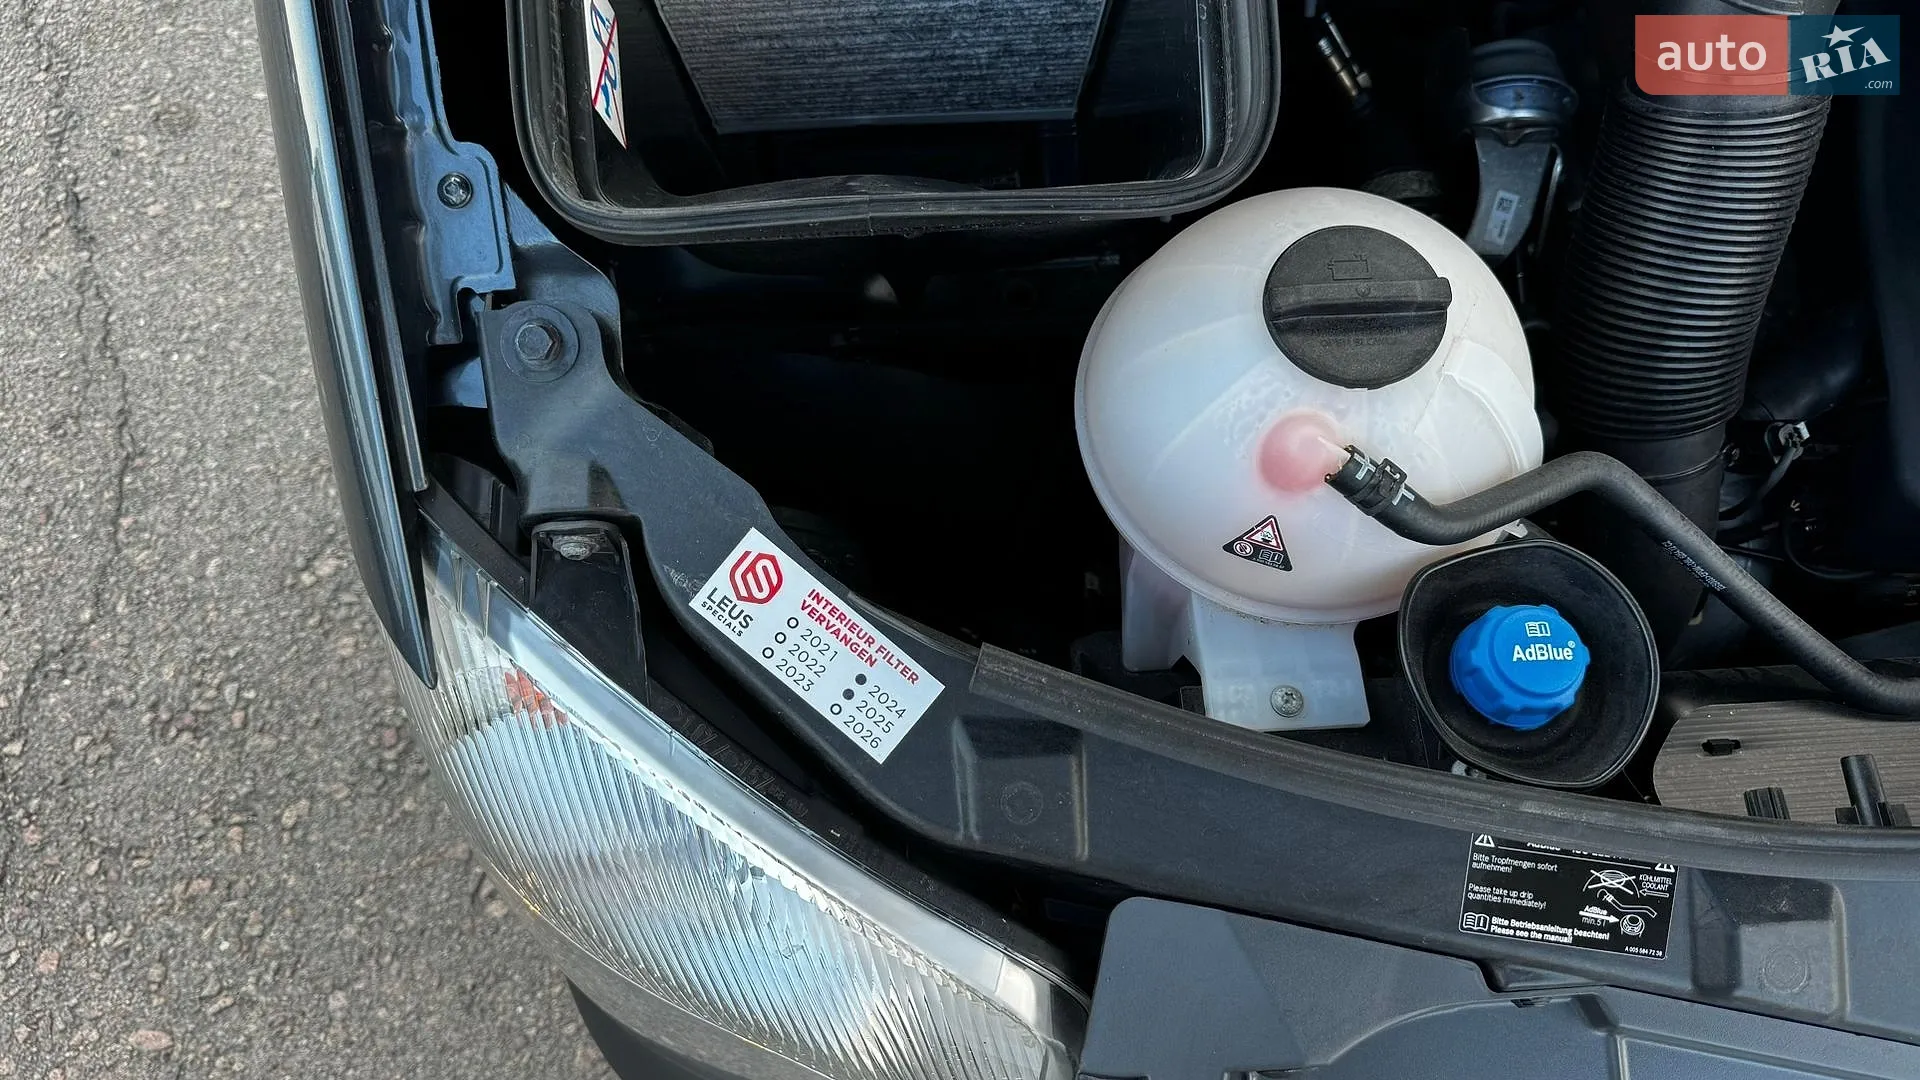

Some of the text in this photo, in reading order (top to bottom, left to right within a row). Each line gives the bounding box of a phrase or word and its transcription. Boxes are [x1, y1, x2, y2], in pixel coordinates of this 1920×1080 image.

[701, 601, 744, 637] SPECIALS
[706, 587, 754, 630] LEUS
[800, 599, 878, 668] VERVANGEN
[801, 628, 838, 662] 2021
[807, 588, 920, 686] INTERIEUR FILTER
[776, 658, 815, 692] 2023
[788, 644, 827, 678] 2022
[856, 700, 895, 734] 2025
[868, 685, 907, 719] 2024
[843, 715, 882, 749] 2026
[1471, 861, 1513, 873] aufnehmen!
[1472, 852, 1558, 872] Bitte Tropfmengen sofort
[1639, 873, 1673, 885] KÜHLMITTEL
[1467, 892, 1547, 910] quantities immediately!
[1468, 883, 1534, 900] Please take up drip
[1641, 881, 1669, 891] COOLANT
[1584, 905, 1608, 916] AdBlue
[1490, 925, 1573, 944] Please see the manual!
[1491, 916, 1610, 940] Bitte Betriebsanleitung beachten!
